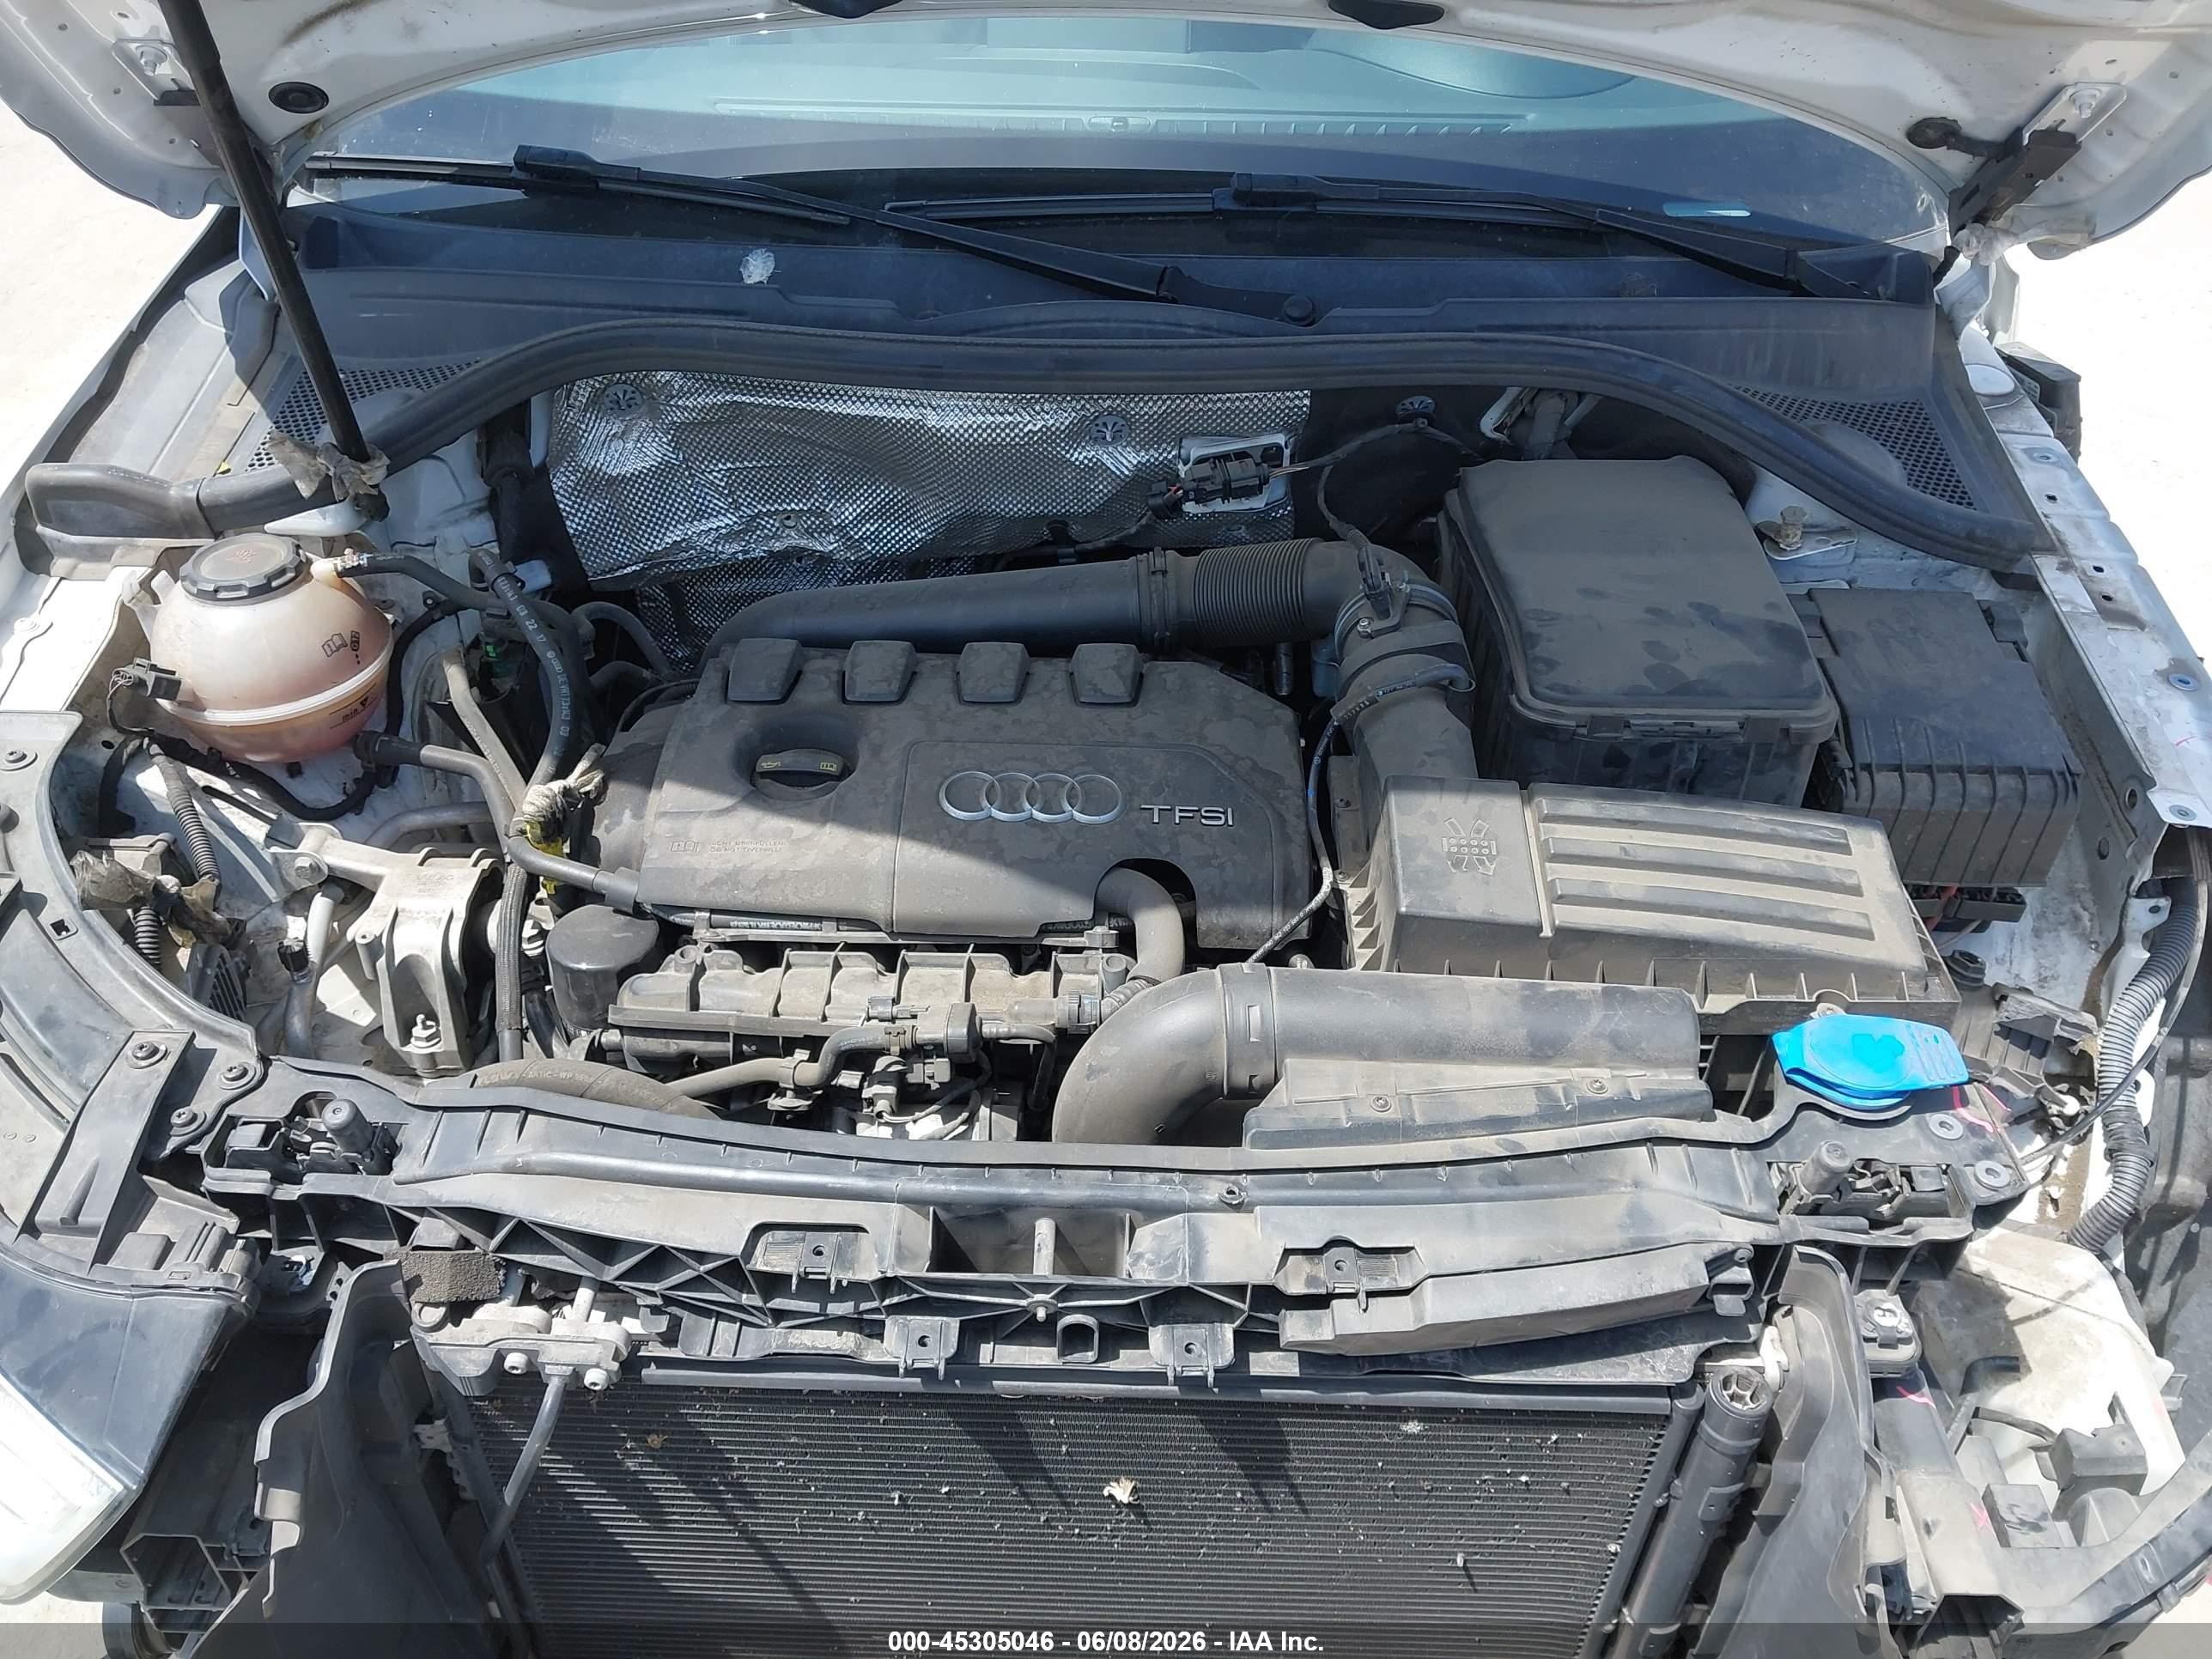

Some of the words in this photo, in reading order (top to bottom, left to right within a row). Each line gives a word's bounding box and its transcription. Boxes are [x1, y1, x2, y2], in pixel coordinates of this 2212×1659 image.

[526, 619, 538, 631] 22
[342, 708, 358, 722] min
[1139, 805, 1233, 825] TFSI
